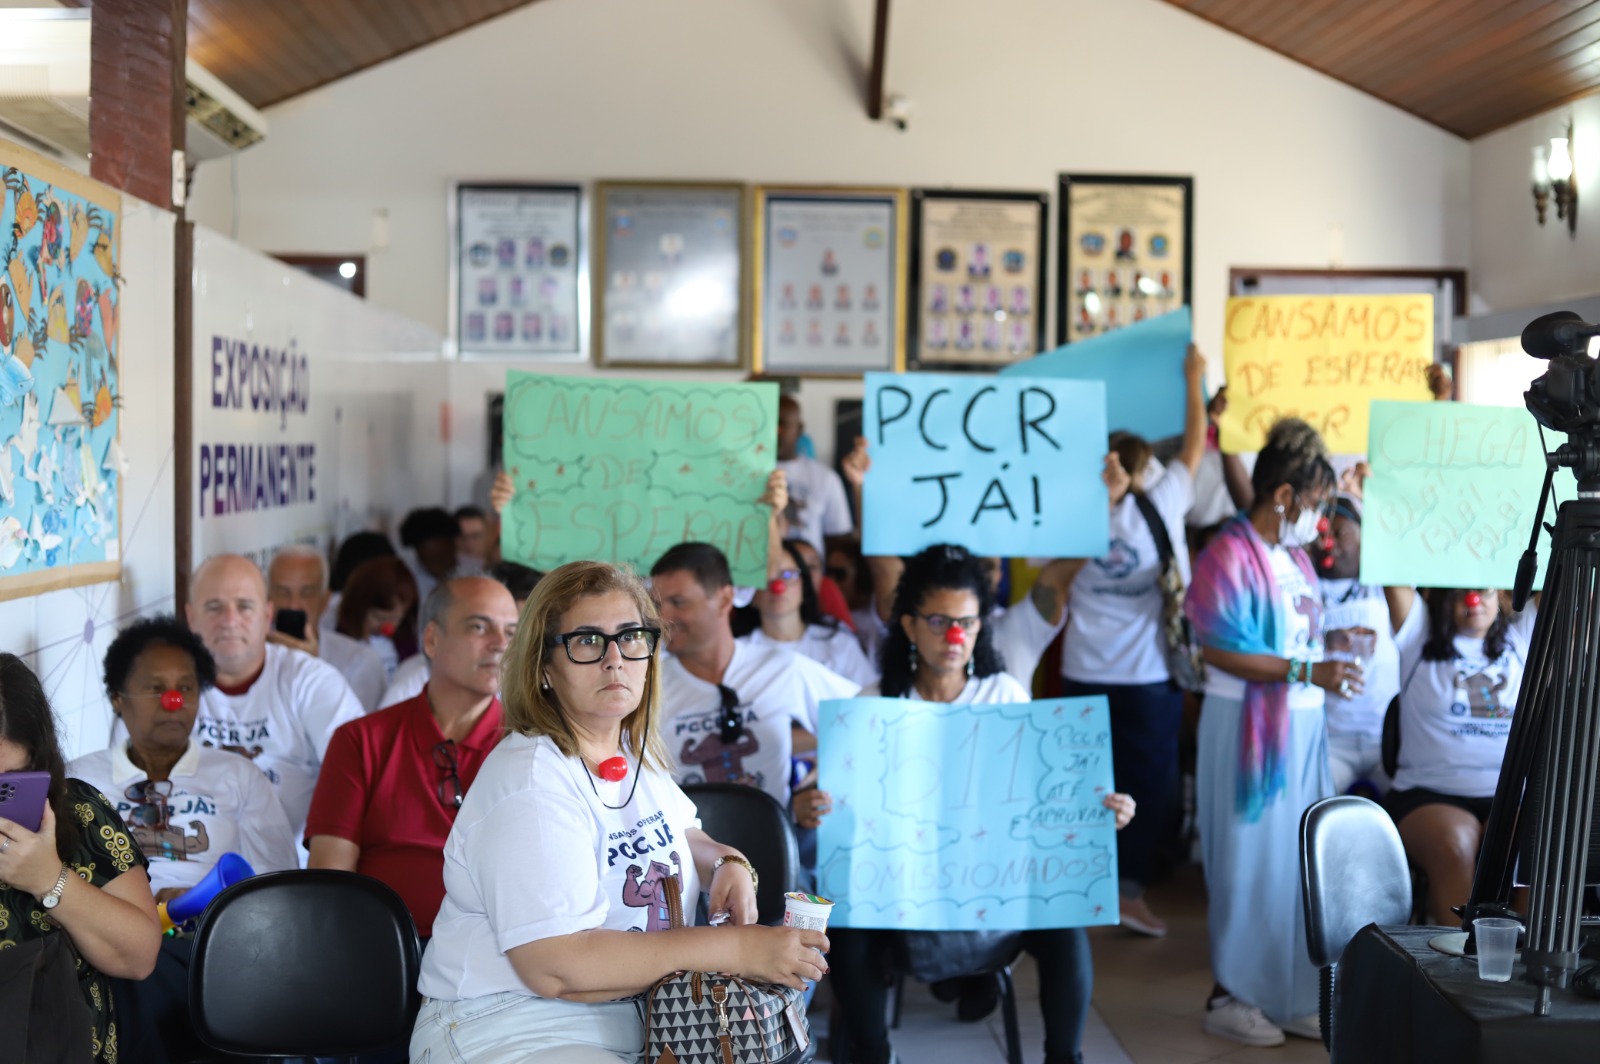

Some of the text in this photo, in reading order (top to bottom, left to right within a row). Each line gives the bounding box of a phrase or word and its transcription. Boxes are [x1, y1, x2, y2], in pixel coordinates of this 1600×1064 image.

[1226, 299, 1426, 345] CANSAMOS
[211, 335, 310, 431] EXPOSIÇÃO
[1237, 361, 1283, 398] DE
[508, 383, 757, 443] CANSAMOS
[877, 385, 1062, 454] PCCR
[1379, 410, 1527, 468] CHEGA
[199, 443, 316, 517] PERMANENTE
[590, 453, 647, 490] DE
[912, 462, 1042, 528] JÁ!
[526, 500, 765, 565] ESPERAR
[823, 854, 1110, 899] COMISSIONADOS
